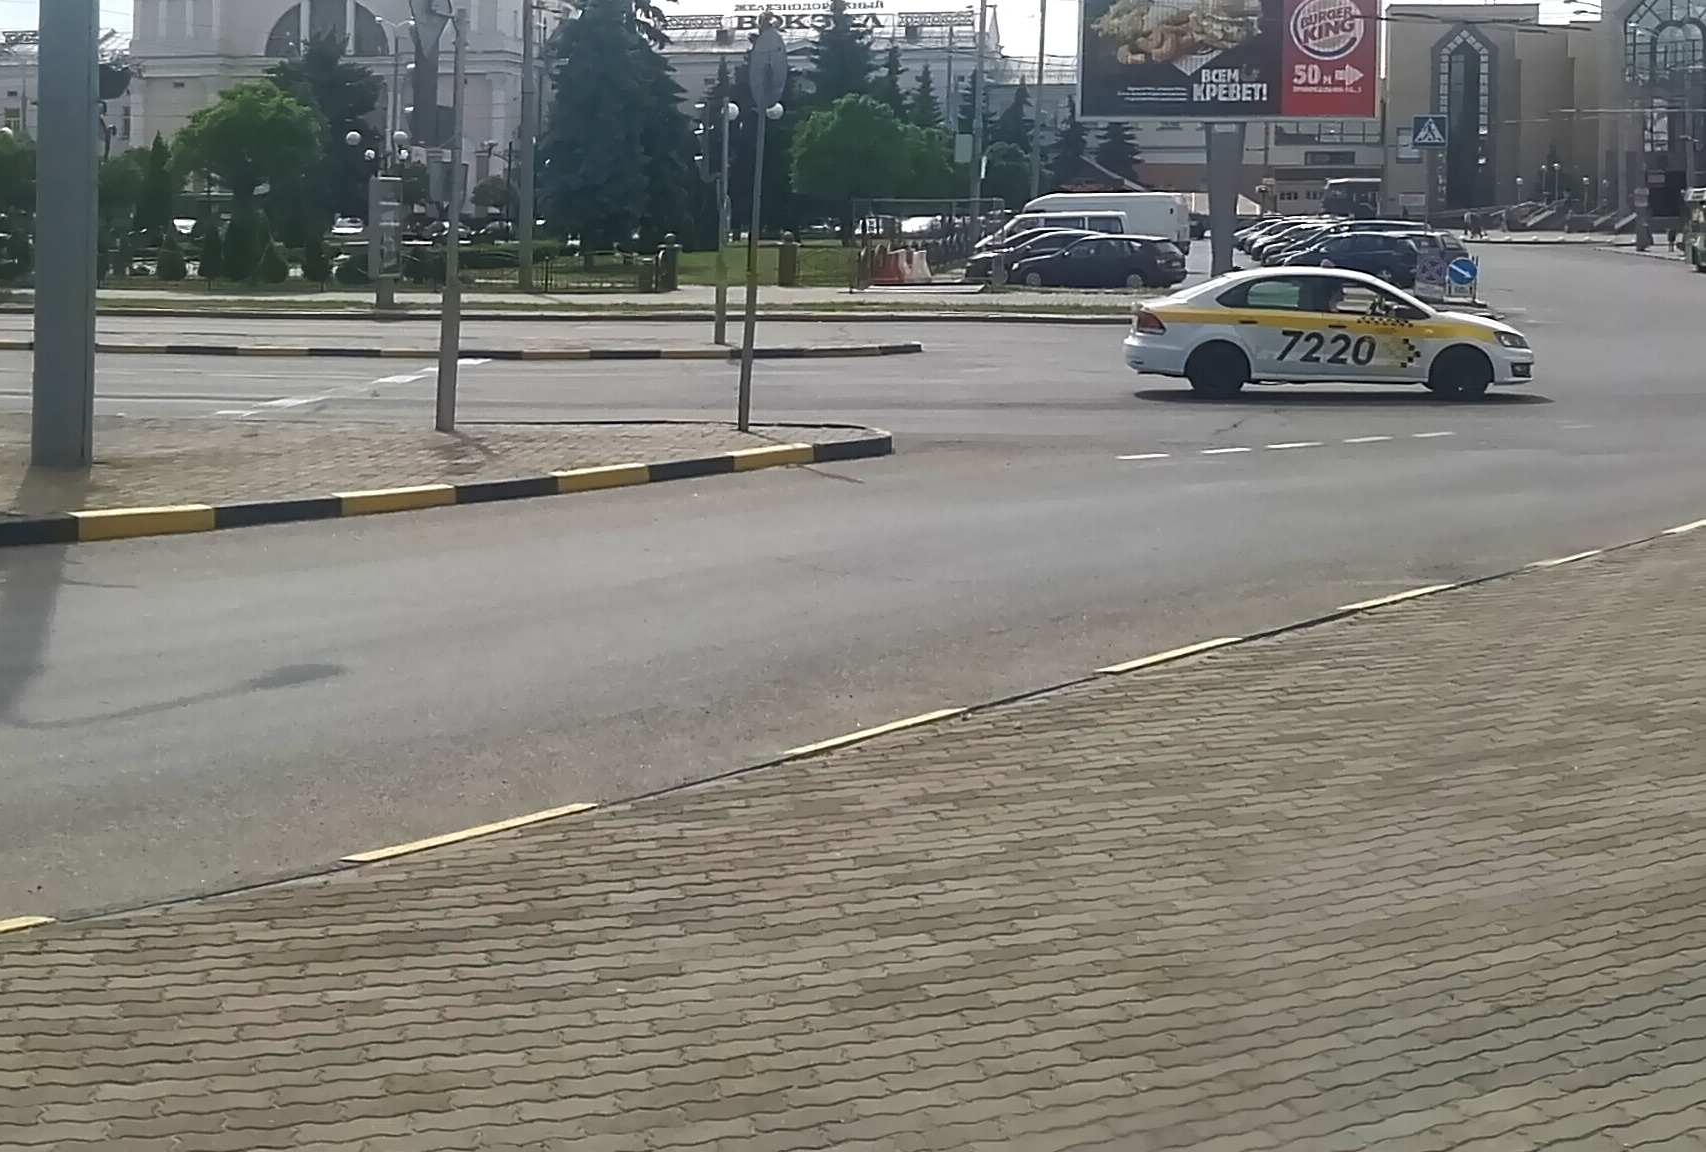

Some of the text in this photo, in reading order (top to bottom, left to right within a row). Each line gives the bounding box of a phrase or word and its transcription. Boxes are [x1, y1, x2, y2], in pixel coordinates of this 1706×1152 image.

[1301, 6, 1352, 29] BURGER
[1303, 19, 1356, 45] KING
[1202, 69, 1239, 83] ВСЕМ
[1293, 64, 1321, 84] 50
[1193, 83, 1268, 101] КРЕВЕТ!
[1276, 330, 1377, 366] 7220
